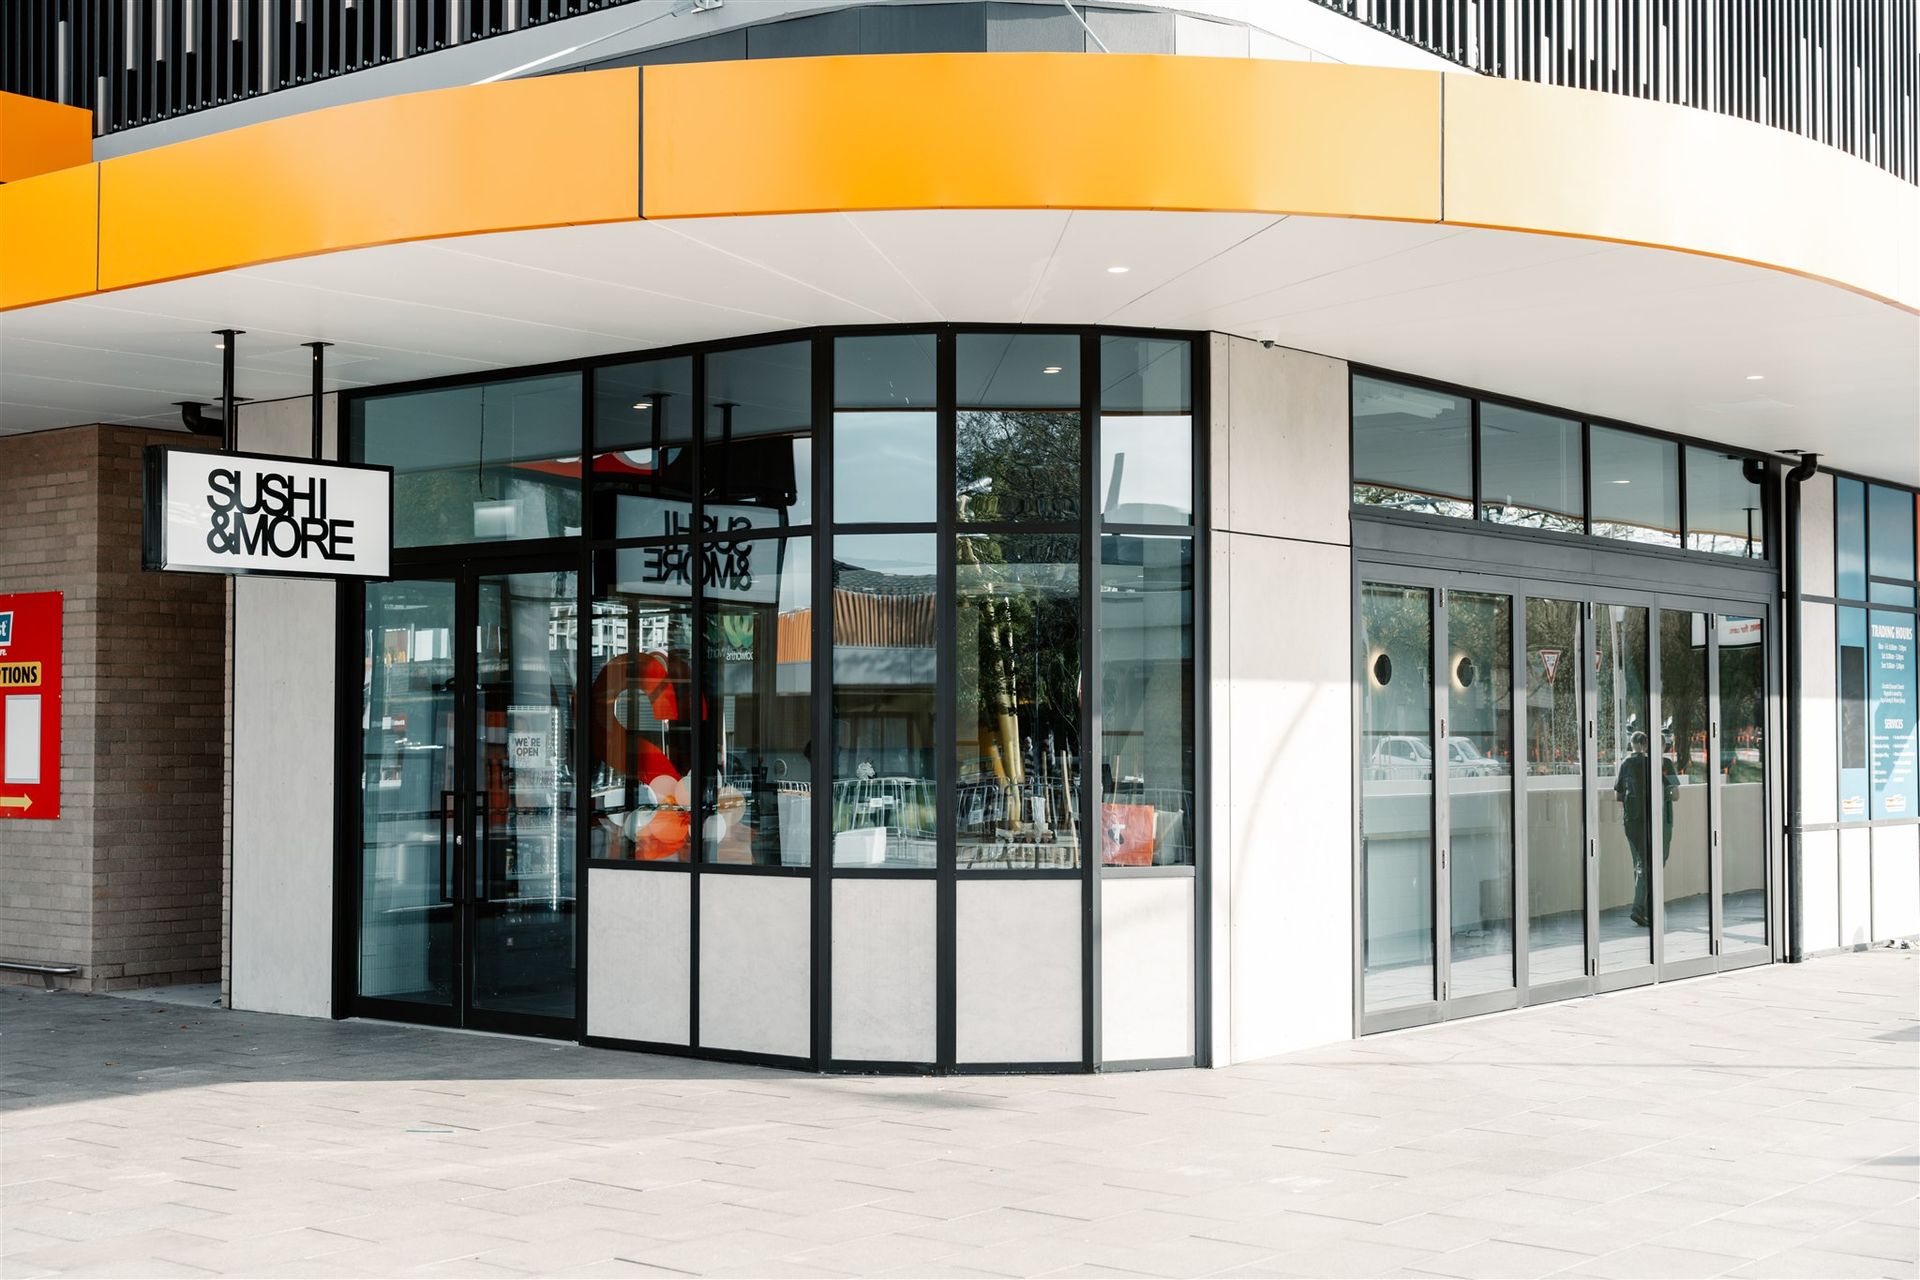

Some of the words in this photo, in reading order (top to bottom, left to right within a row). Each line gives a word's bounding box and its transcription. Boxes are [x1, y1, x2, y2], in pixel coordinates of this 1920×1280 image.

[207, 468, 327, 519] SUSHI
[206, 509, 355, 562] &MORE
[1871, 624, 1895, 639] TRADING
[1895, 626, 1913, 640] HOURS
[0, 665, 38, 684] TIONS
[1884, 718, 1904, 729] SERVICES
[516, 747, 539, 757] OPEN
